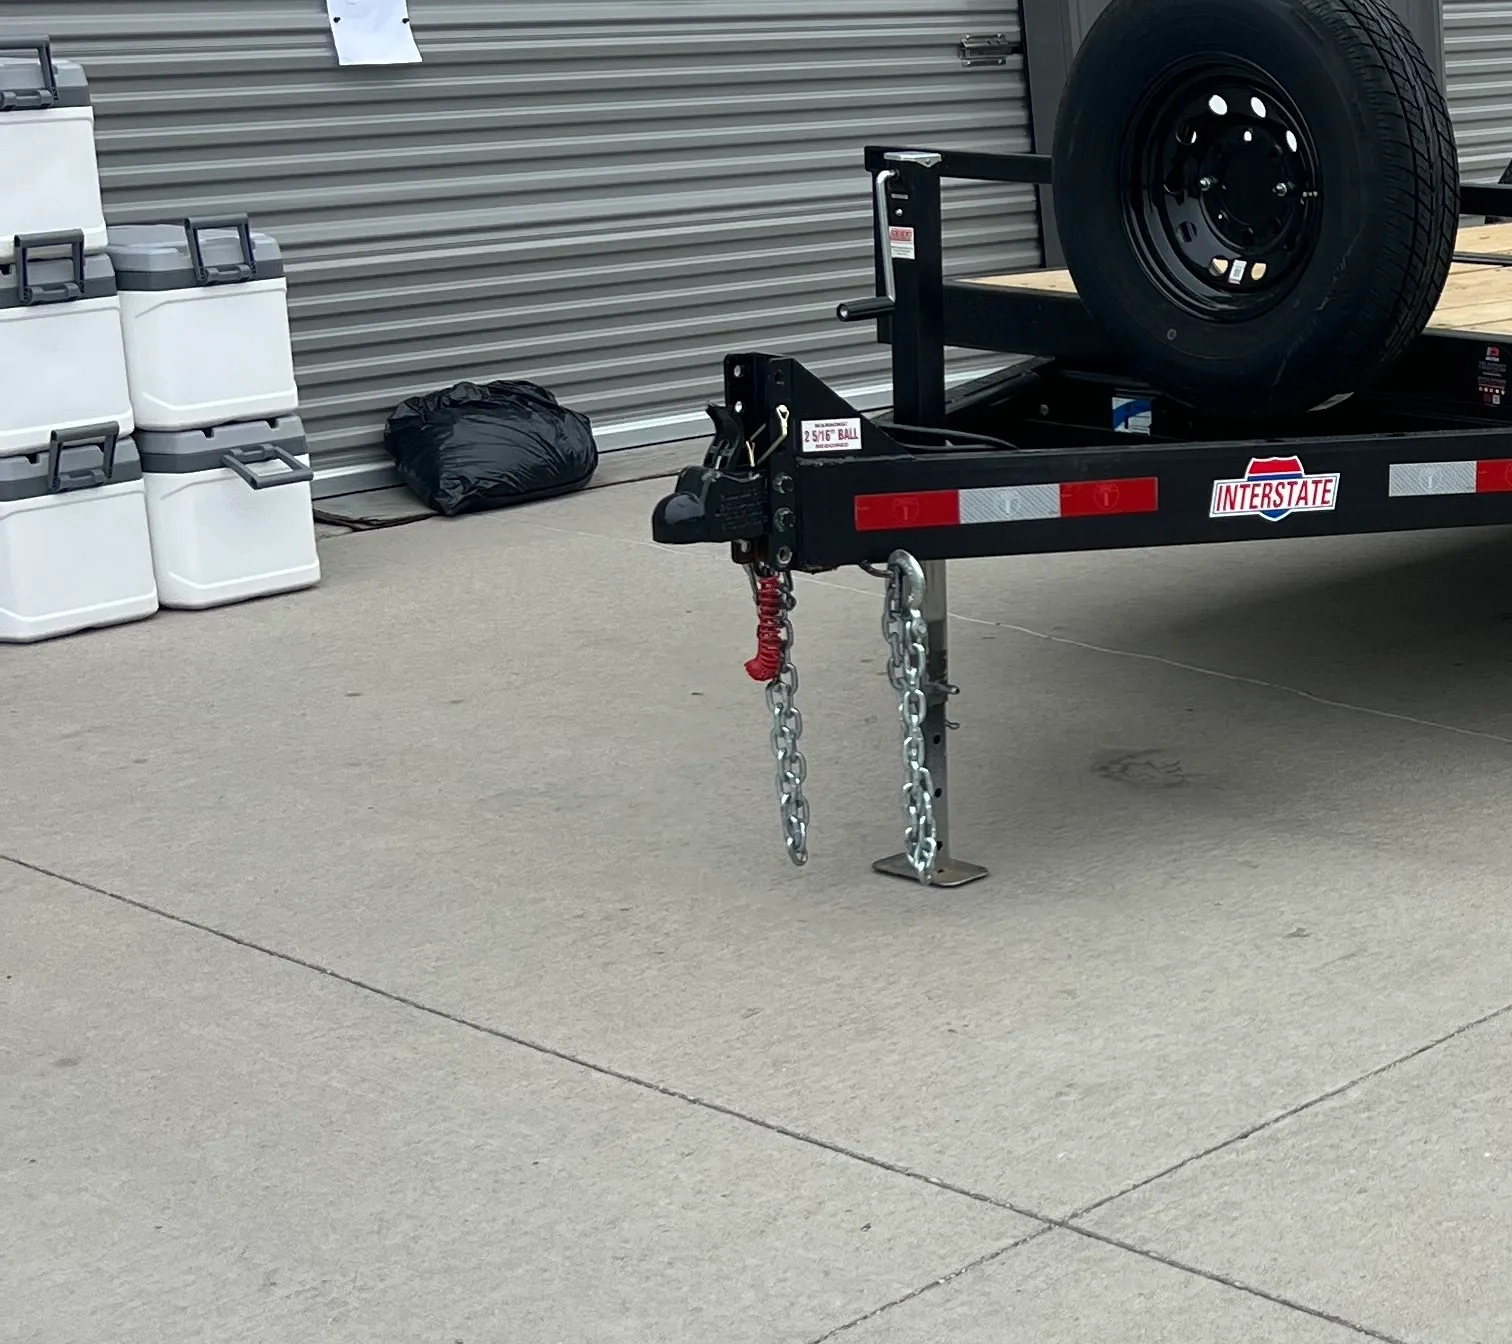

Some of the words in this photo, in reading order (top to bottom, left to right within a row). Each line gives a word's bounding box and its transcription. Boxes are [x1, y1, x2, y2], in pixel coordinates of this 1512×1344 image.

[804, 430, 810, 442] 2
[838, 428, 859, 441] BALL
[1216, 479, 1333, 512] INTERSTATE
